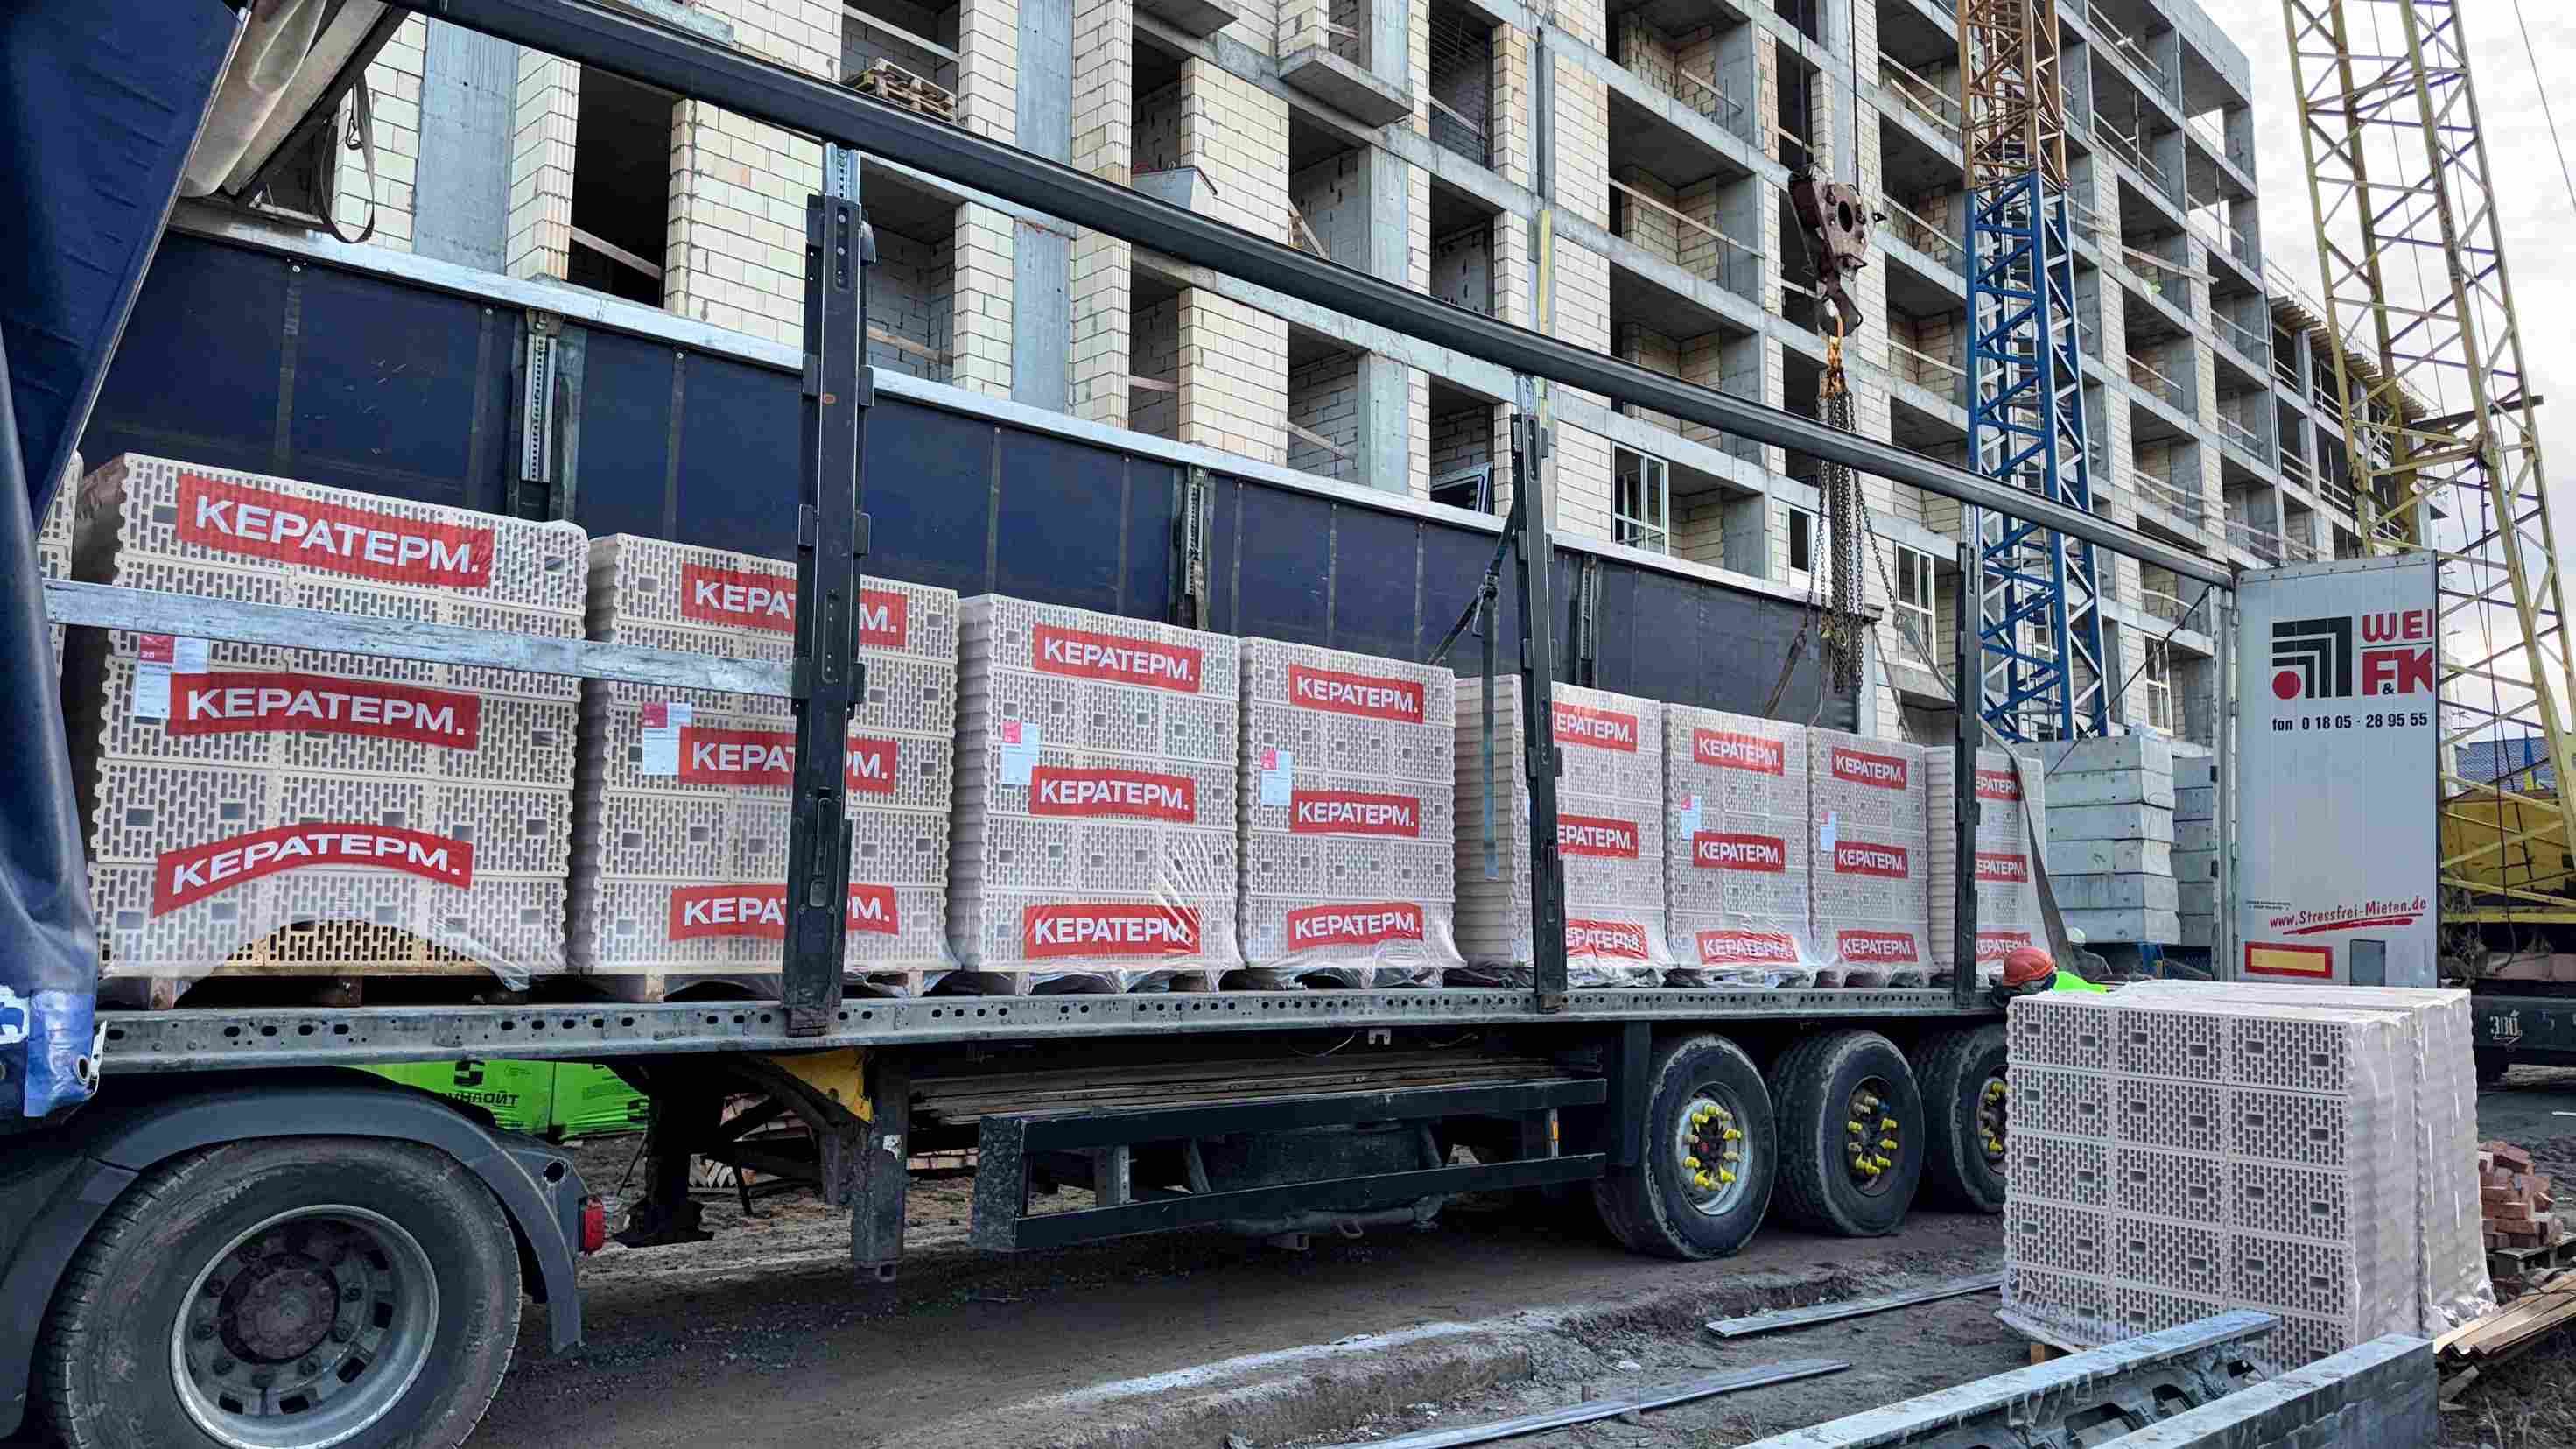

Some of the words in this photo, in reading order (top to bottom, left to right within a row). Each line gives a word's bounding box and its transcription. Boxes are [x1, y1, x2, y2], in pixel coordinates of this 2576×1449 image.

[195, 495, 479, 573] КЕРАТЕРМ.
[1044, 637, 1194, 682] КЕРАТЕРМ.
[1296, 675, 1419, 714] КЕРАТЕРМ.
[187, 687, 465, 736] КЕРАТЕРМ.
[2366, 714, 2383, 728] 28
[2388, 713, 2405, 728] 95
[2411, 712, 2428, 727] 55
[1699, 736, 1782, 768] КЕРАТЕРМ.
[1835, 754, 1905, 784] КЕРАТЕРМ.
[1039, 777, 1190, 812] КЕРАТЕРМ.
[1298, 800, 1415, 828] КЕРАТЕРМ.
[1557, 825, 1634, 851] ЕРАТЕРМ.
[1699, 840, 1782, 865] КЕРАТЕРМ.
[173, 834, 460, 895] КЕРАТЕРМ.
[1838, 848, 1906, 872] КЕРАТЕРМ.
[1295, 911, 1421, 939] КЕРАТЕРМ.
[1843, 937, 1914, 957] КЕРАТЕРМ.
